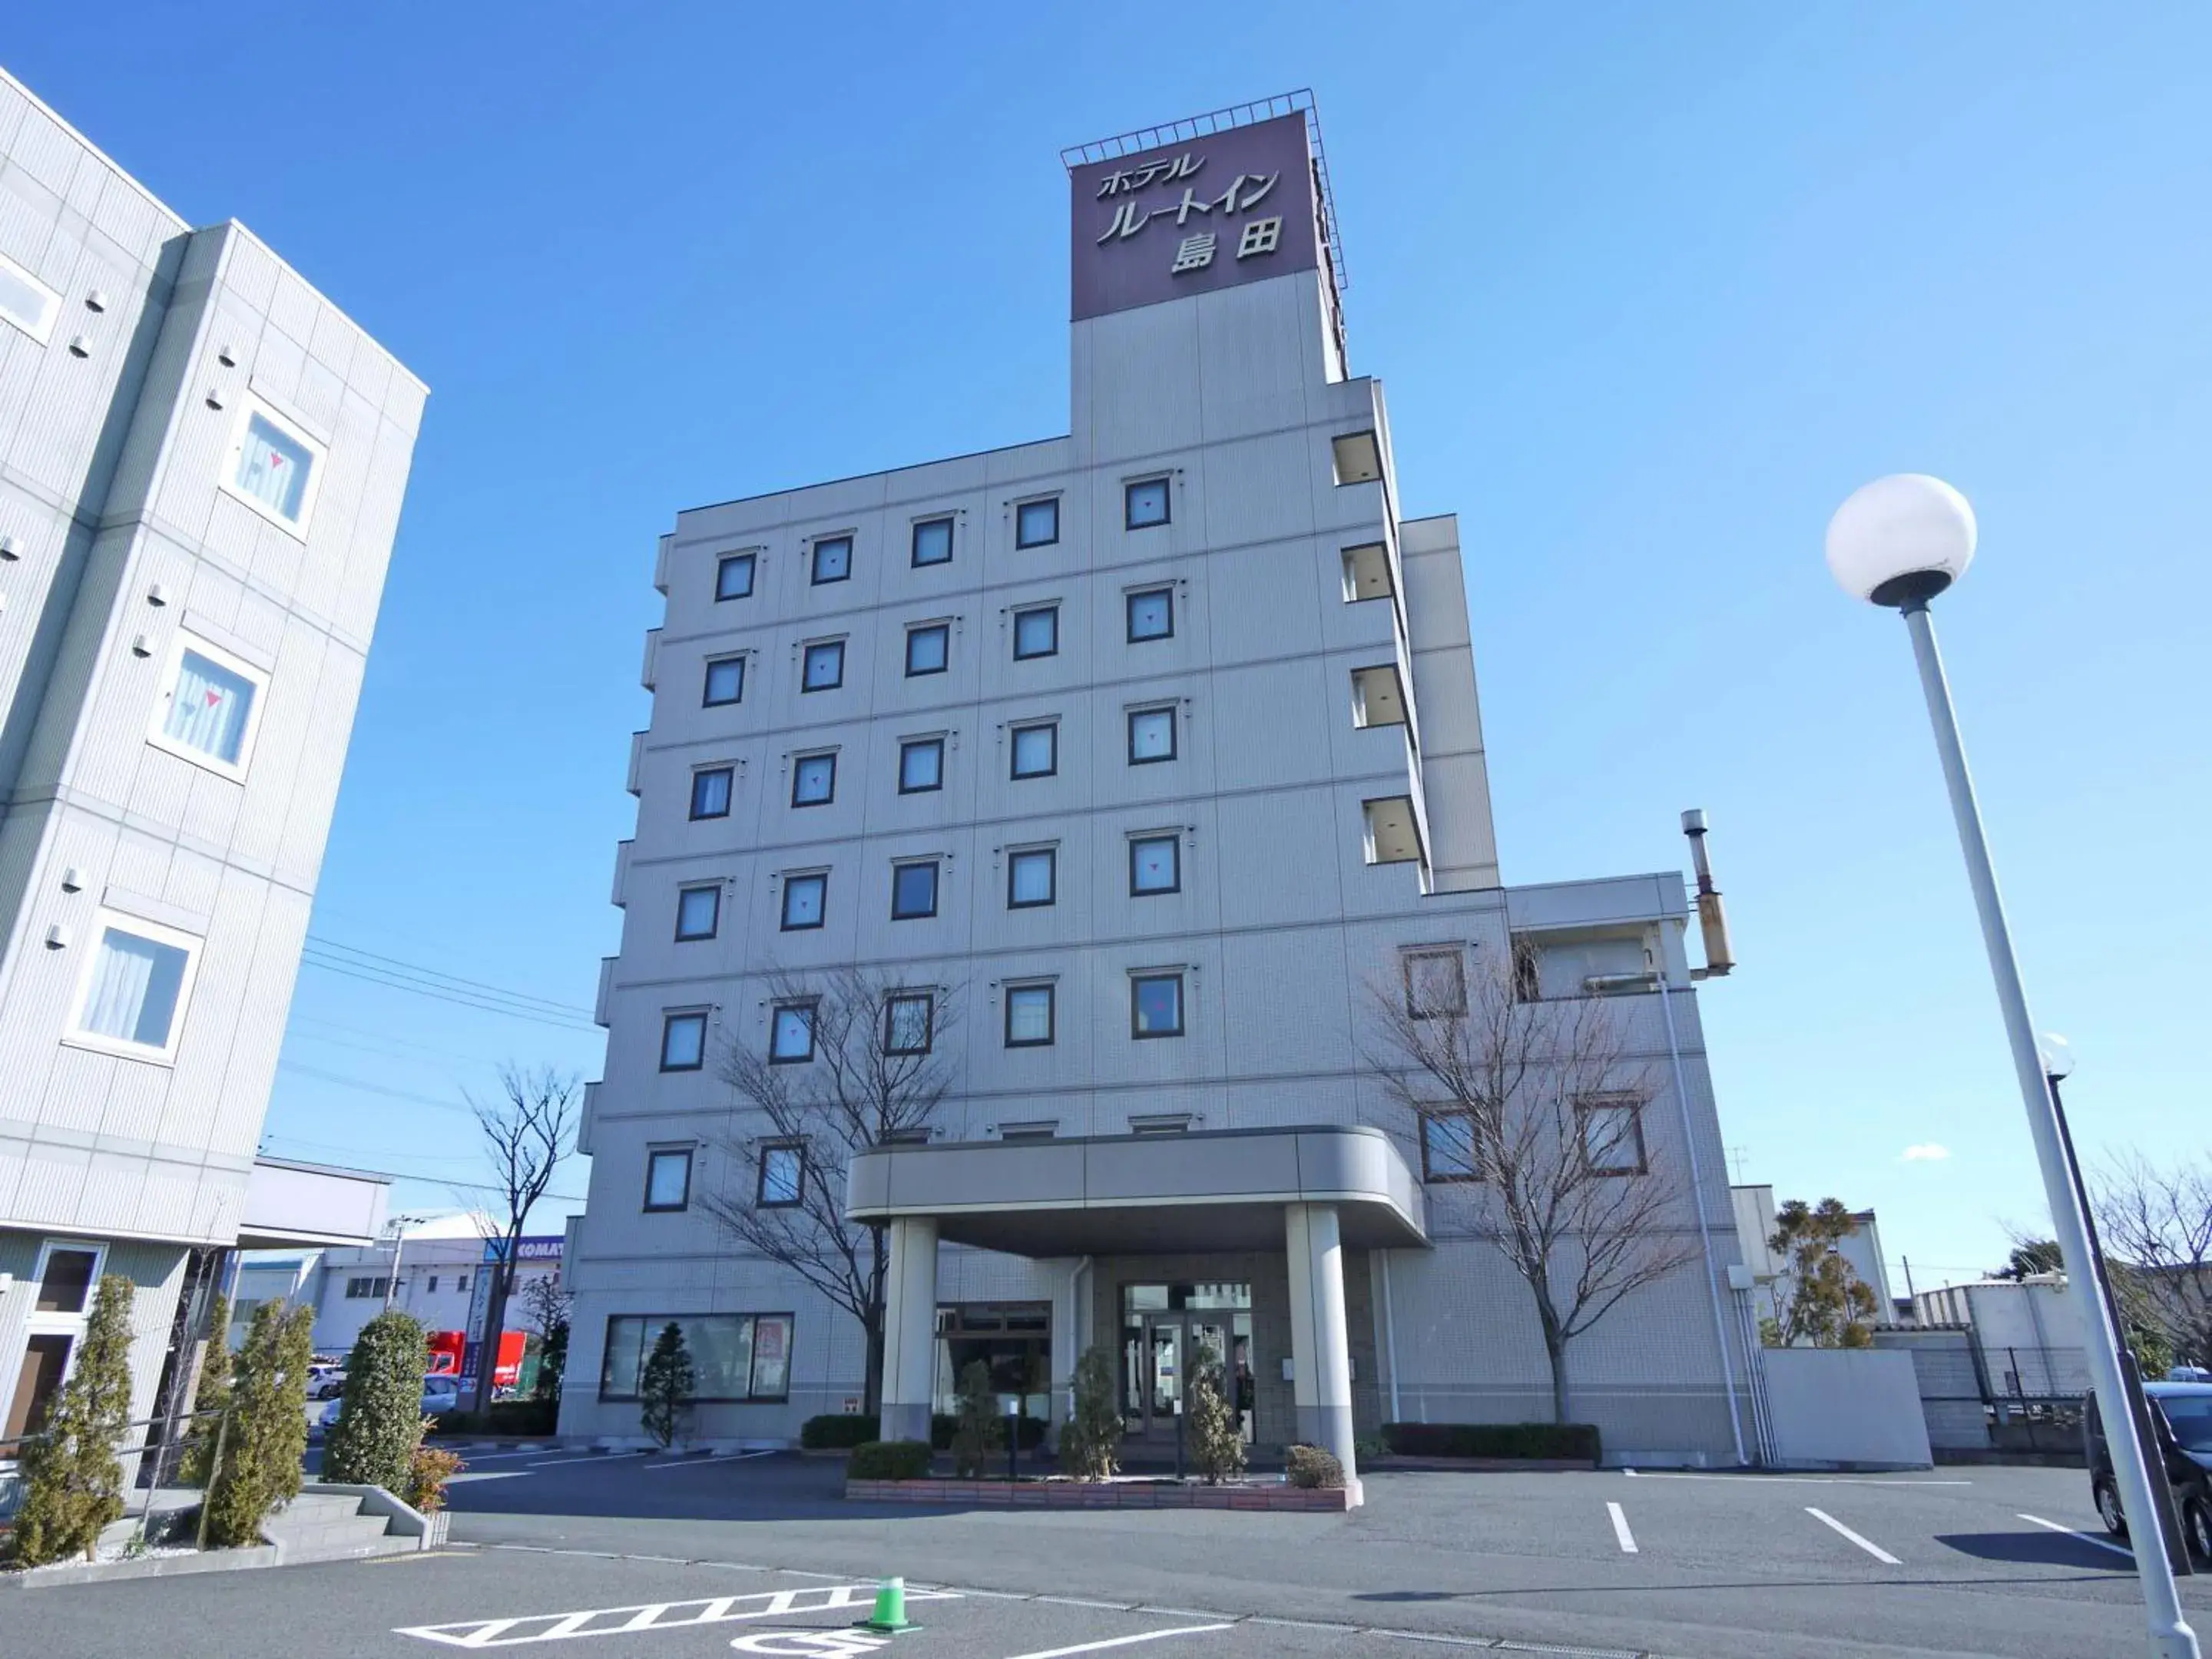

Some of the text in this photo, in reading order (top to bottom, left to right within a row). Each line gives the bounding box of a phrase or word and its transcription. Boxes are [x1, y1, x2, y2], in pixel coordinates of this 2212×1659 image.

[1097, 152, 1206, 197] ホテル
[1097, 170, 1280, 244] ルートイン
[1171, 215, 1283, 274] 島田
